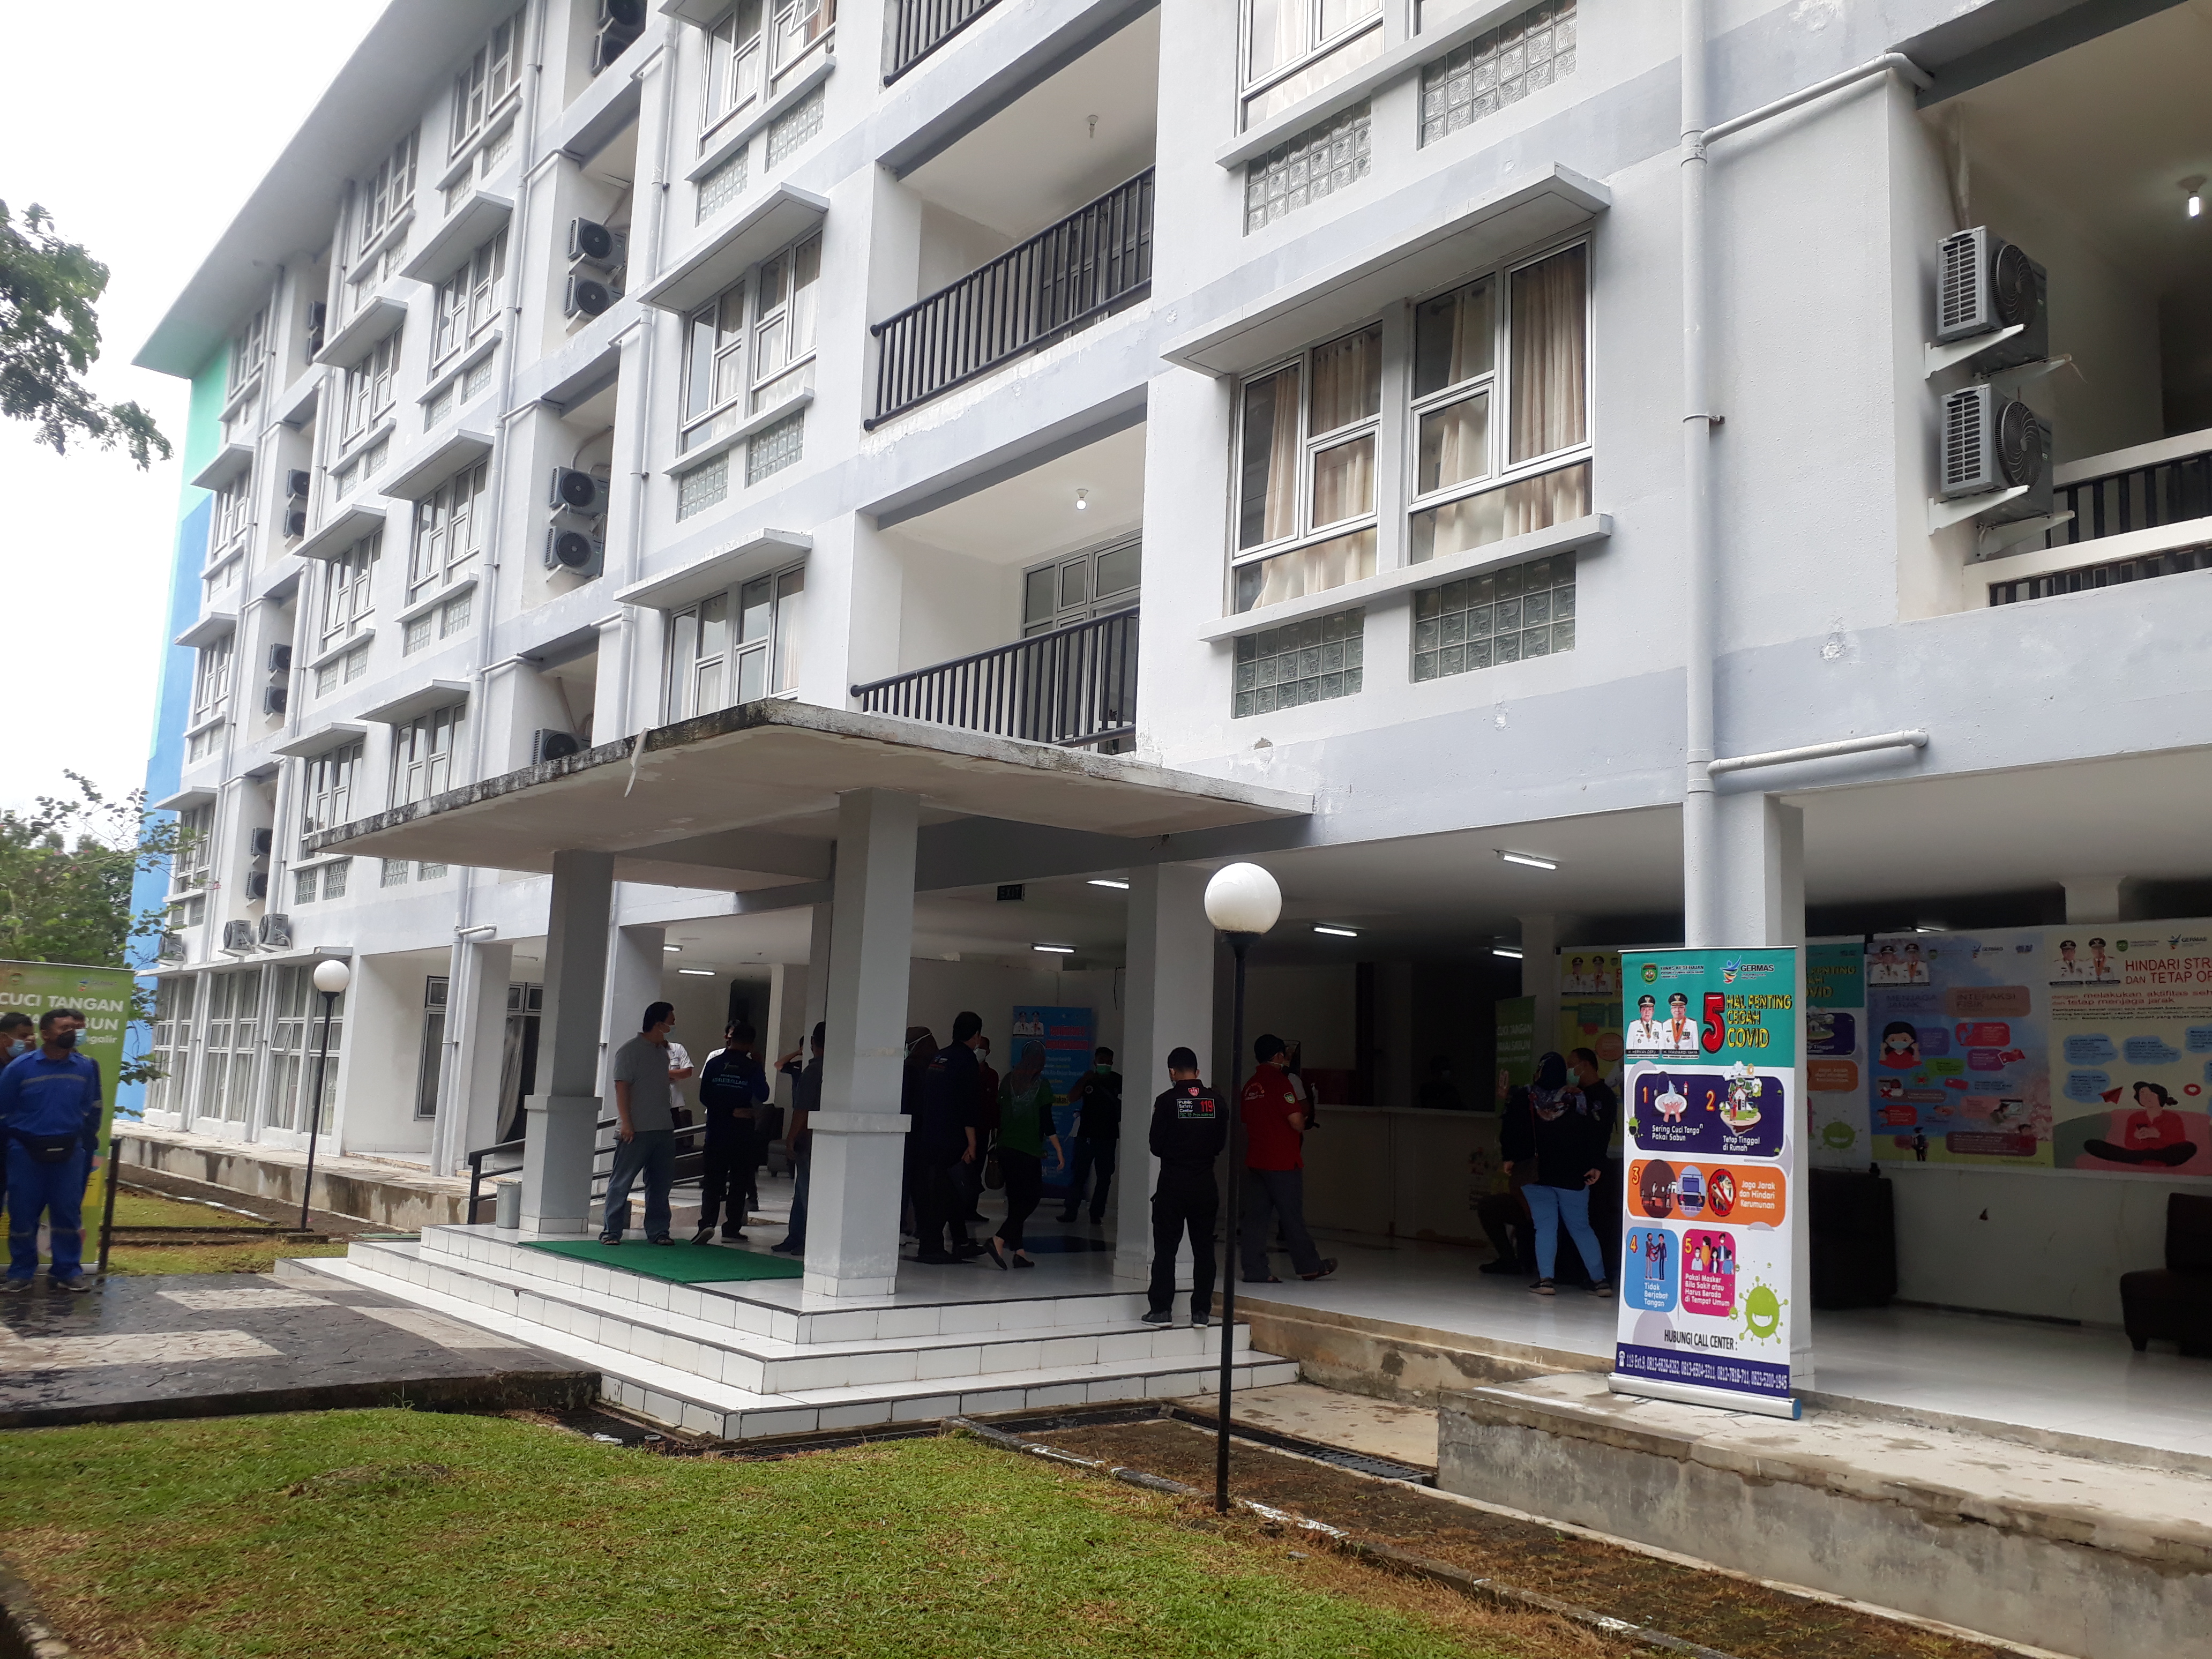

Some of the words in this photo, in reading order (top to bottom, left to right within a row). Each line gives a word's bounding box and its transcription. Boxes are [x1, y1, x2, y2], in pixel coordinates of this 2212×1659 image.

[1000, 887, 1020, 898] EXIT
[1812, 966, 1856, 974] PENTING
[2126, 958, 2179, 972] HINDARI
[2126, 975, 2146, 984] DAN
[2150, 971, 2192, 983] TETAP
[47, 995, 124, 1012] TANGAN
[1726, 995, 1746, 1009] HAL
[1748, 995, 1792, 1010] PENTING
[1701, 992, 1725, 1054] 5
[1727, 1010, 1761, 1025] CEGAH
[1727, 1027, 1769, 1048] COVID
[1642, 1086, 1648, 1103] 1
[1706, 1089, 1716, 1111] 2
[1200, 1100, 1214, 1112] 119
[1652, 1125, 1670, 1133] Sering
[1723, 1135, 1738, 1144] Tetap
[1739, 1136, 1760, 1146] Tinggal
[1632, 1166, 1640, 1185] 3
[1742, 1180, 1756, 1190] Jaga
[1758, 1181, 1776, 1190] Jarak
[1739, 1189, 1750, 1198] dan
[1752, 1191, 1775, 1199] Hindari
[1740, 1199, 1775, 1209] Kerumunan
[1630, 1235, 1638, 1253] 4
[1685, 1237, 1693, 1254] 5
[1685, 1273, 1700, 1281] Pakai
[1702, 1275, 1722, 1283] Masker
[1644, 1282, 1661, 1290] Tidak
[1697, 1282, 1710, 1290] Sakit
[1644, 1290, 1669, 1299] Berjabat
[1702, 1290, 1722, 1298] Berada
[1644, 1298, 1665, 1308] Tangan
[1692, 1296, 1711, 1305] Tempat
[1712, 1299, 1730, 1307] Umum
[1664, 1329, 1693, 1345] HUBUNGI
[1694, 1333, 1709, 1347] CALL
[1710, 1335, 1734, 1350] CENTER
